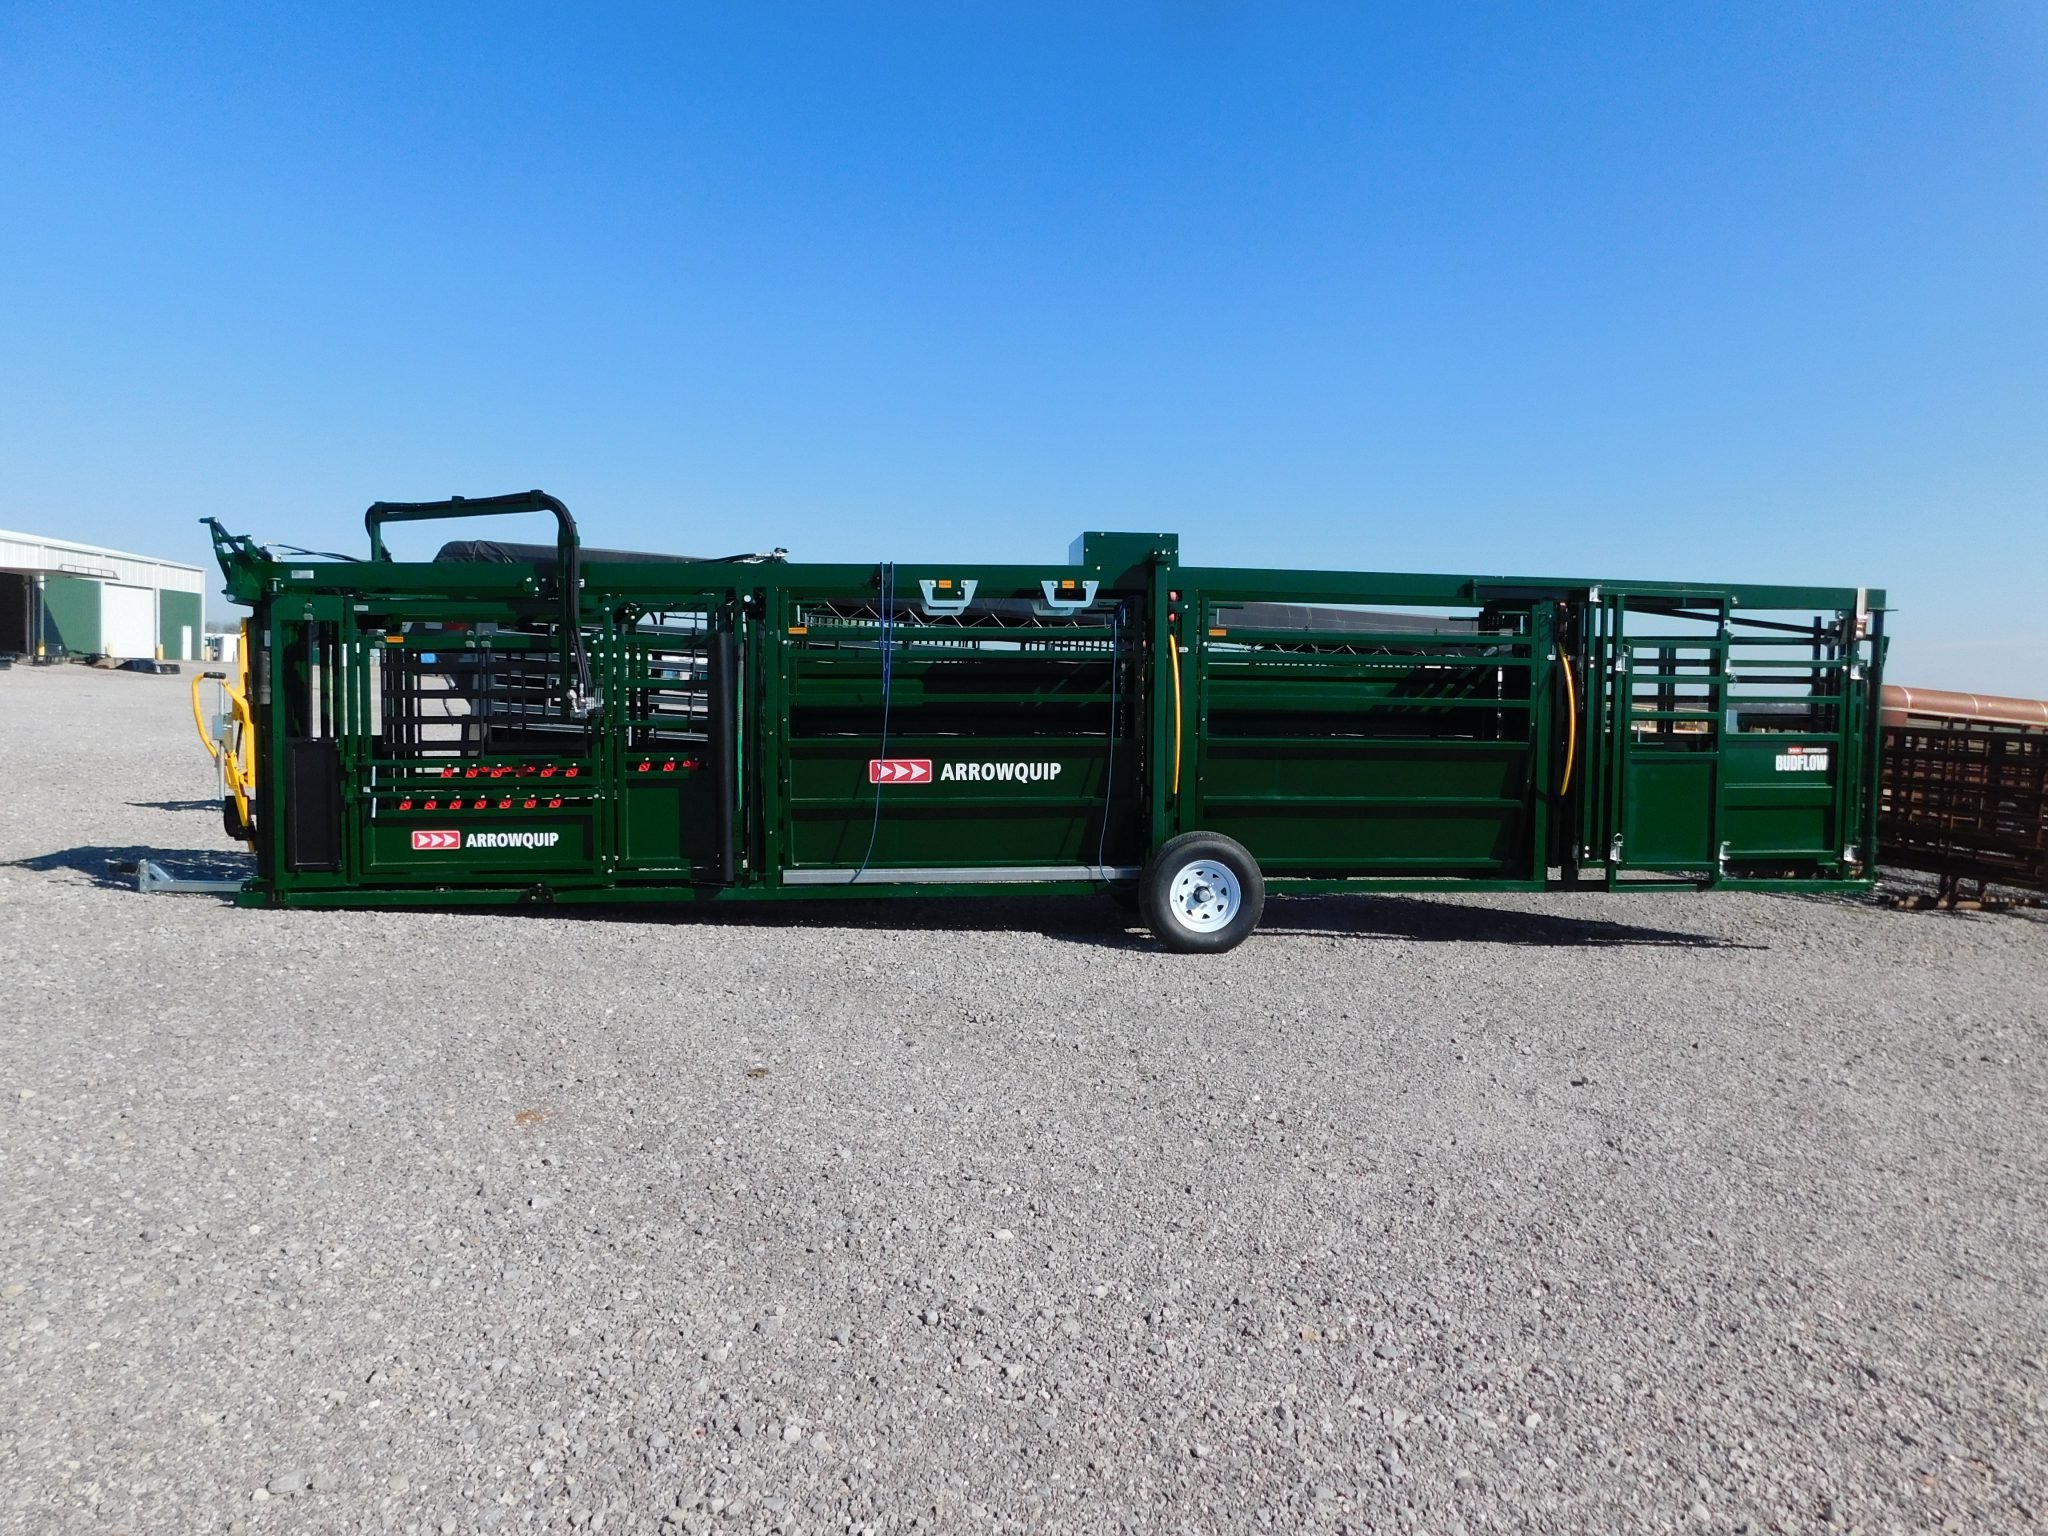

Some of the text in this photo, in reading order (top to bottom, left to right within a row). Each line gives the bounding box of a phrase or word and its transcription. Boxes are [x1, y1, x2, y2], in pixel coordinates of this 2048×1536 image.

[1775, 754, 1829, 771] BUDFLOW
[940, 762, 1062, 783] ARROWQUIP
[465, 832, 560, 849] ARROWQUIP
